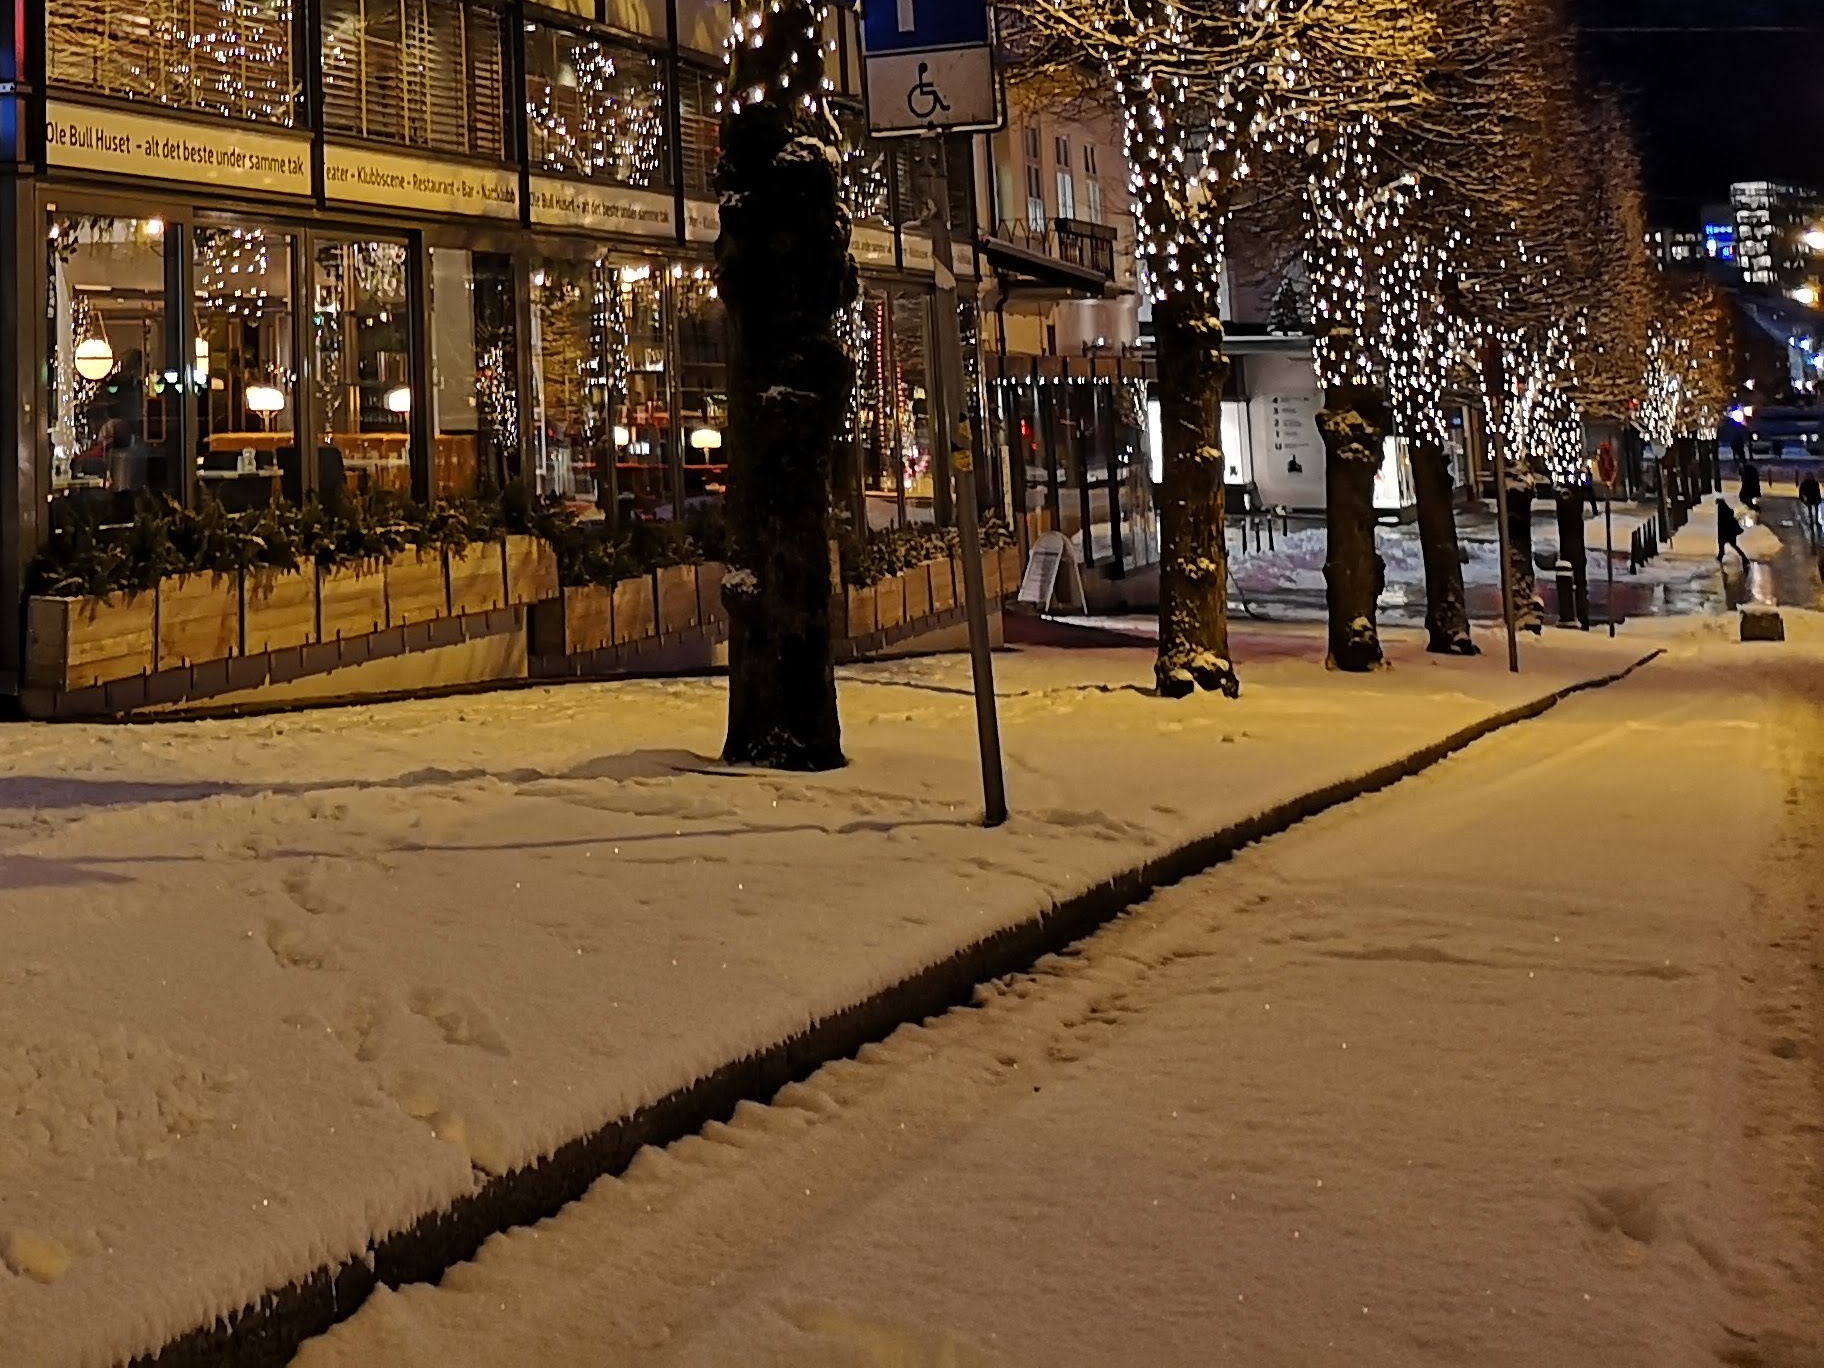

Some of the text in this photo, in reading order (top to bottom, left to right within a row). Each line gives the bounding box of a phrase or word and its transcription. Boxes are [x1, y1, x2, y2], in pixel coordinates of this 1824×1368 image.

[46, 121, 66, 146] Ole
[69, 124, 93, 149] Bull
[96, 129, 130, 154] Huset
[145, 138, 160, 158] alt
[162, 140, 182, 161] det
[183, 145, 214, 165] beste
[216, 149, 246, 169] under
[248, 155, 286, 174] samme
[288, 156, 305, 176] tak
[325, 163, 349, 183] eater
[357, 165, 406, 191] Klubbscene
[412, 173, 456, 197] Restaurant
[462, 181, 475, 198] Bar
